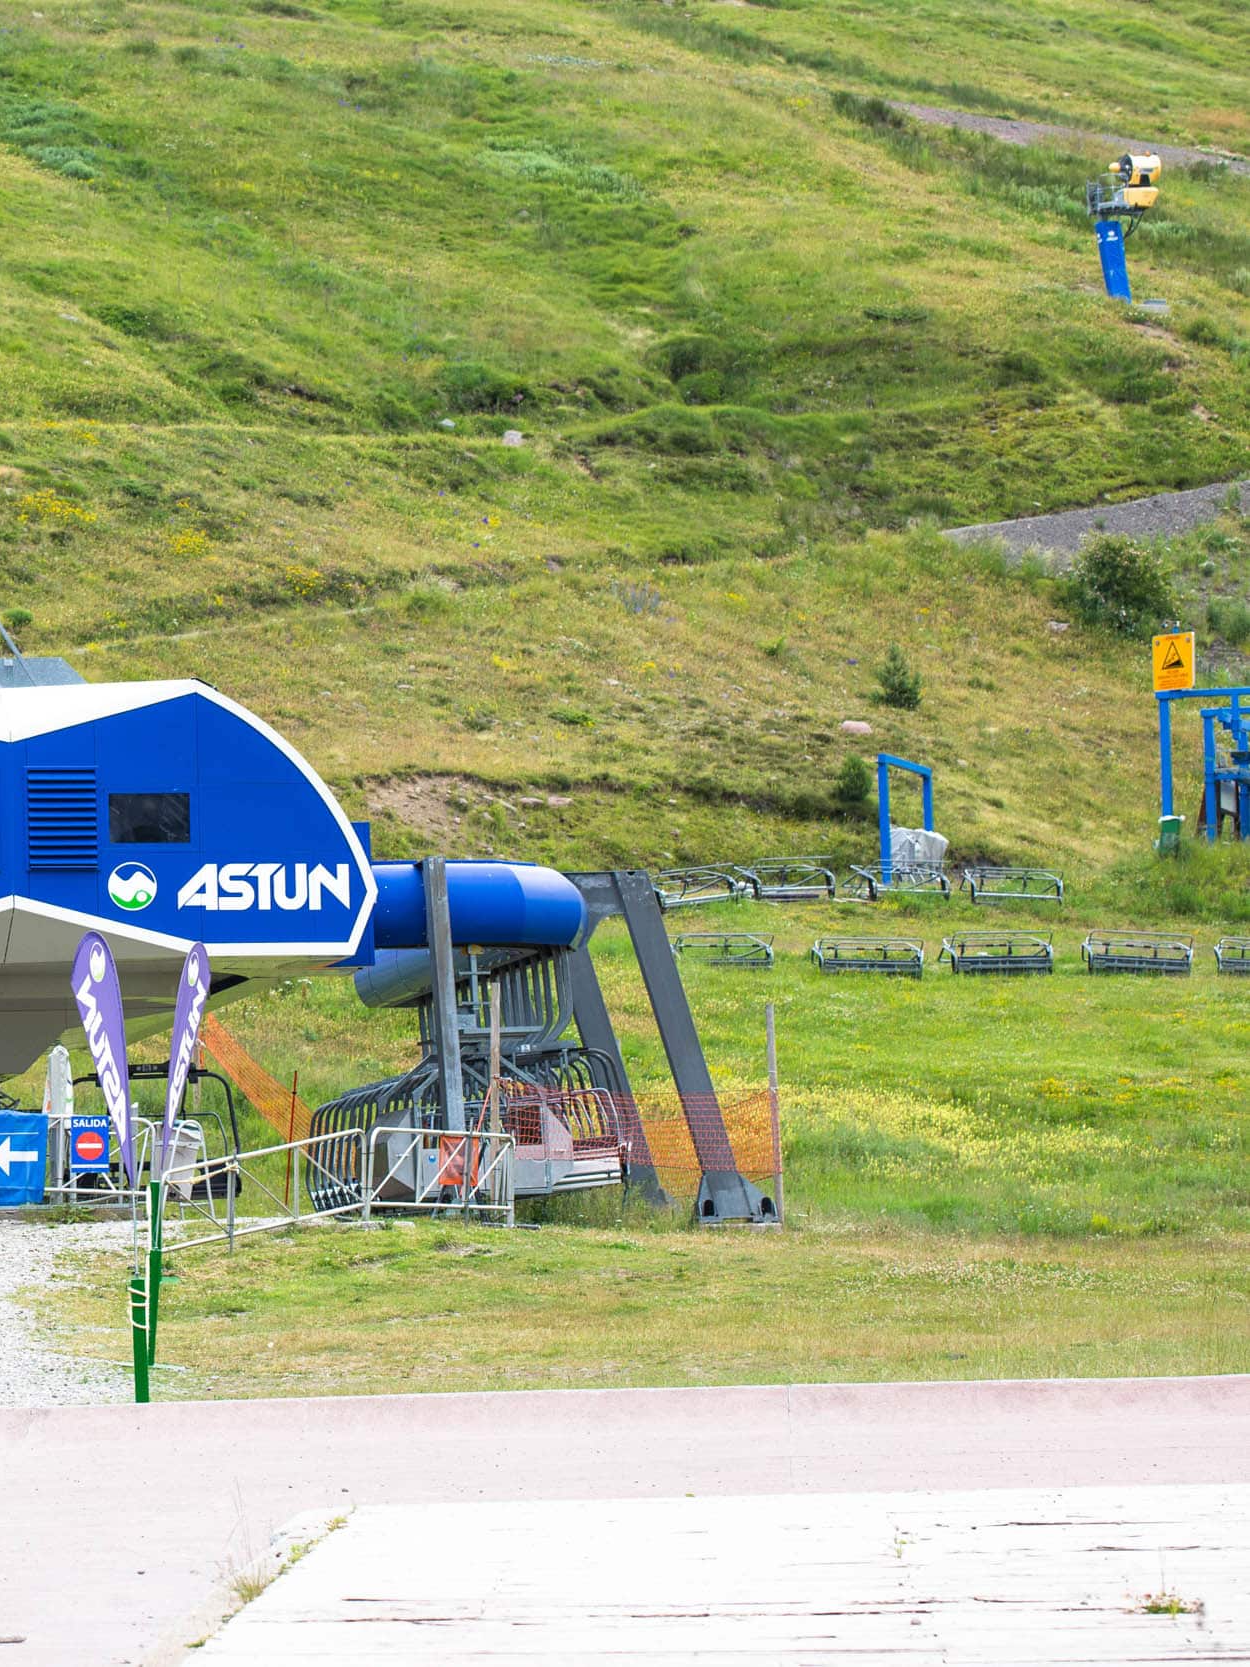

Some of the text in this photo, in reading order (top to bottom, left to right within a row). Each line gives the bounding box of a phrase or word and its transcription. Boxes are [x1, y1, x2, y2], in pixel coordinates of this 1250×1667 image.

[177, 862, 350, 911] ASTUN
[168, 978, 207, 1131] ASTUN
[73, 1119, 107, 1128] SALIDA
